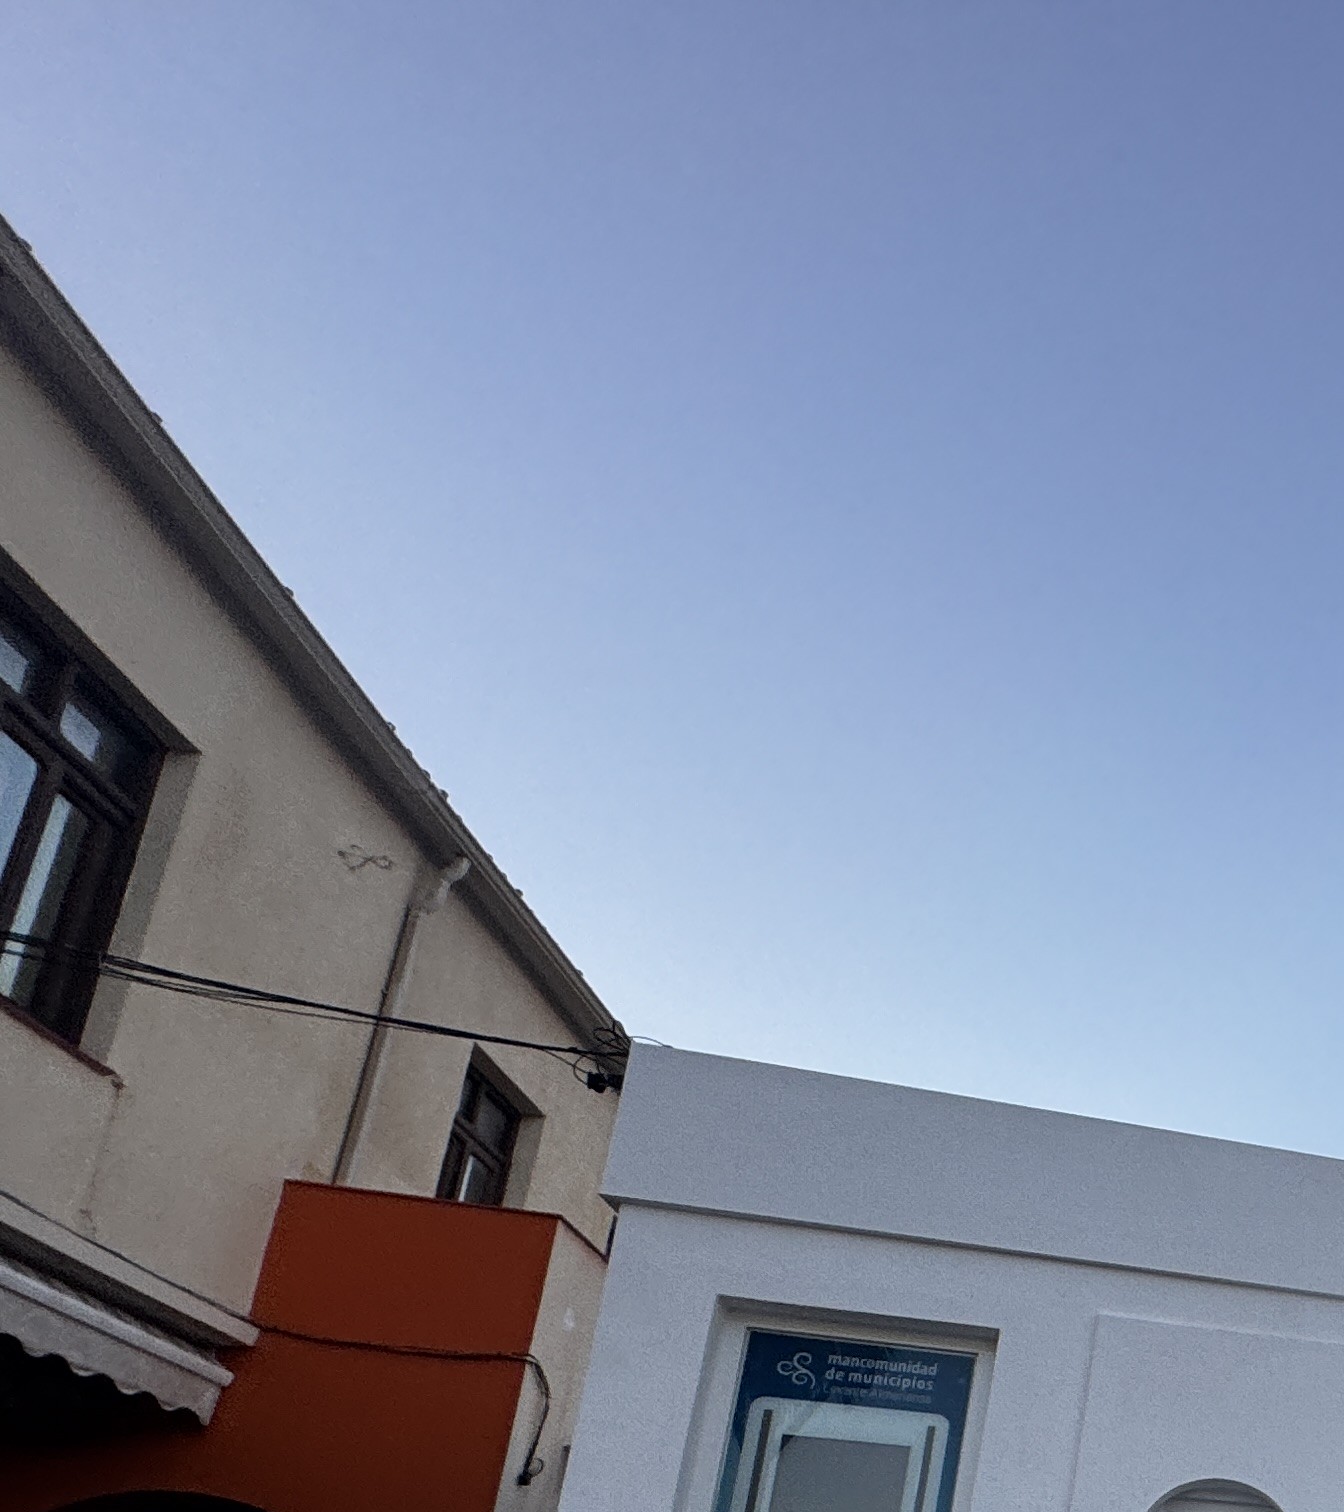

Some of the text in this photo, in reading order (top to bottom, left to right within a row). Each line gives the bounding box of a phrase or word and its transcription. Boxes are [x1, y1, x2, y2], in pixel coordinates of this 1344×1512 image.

[827, 1354, 938, 1376] mancomunidad
[825, 1366, 934, 1391] de municipios
